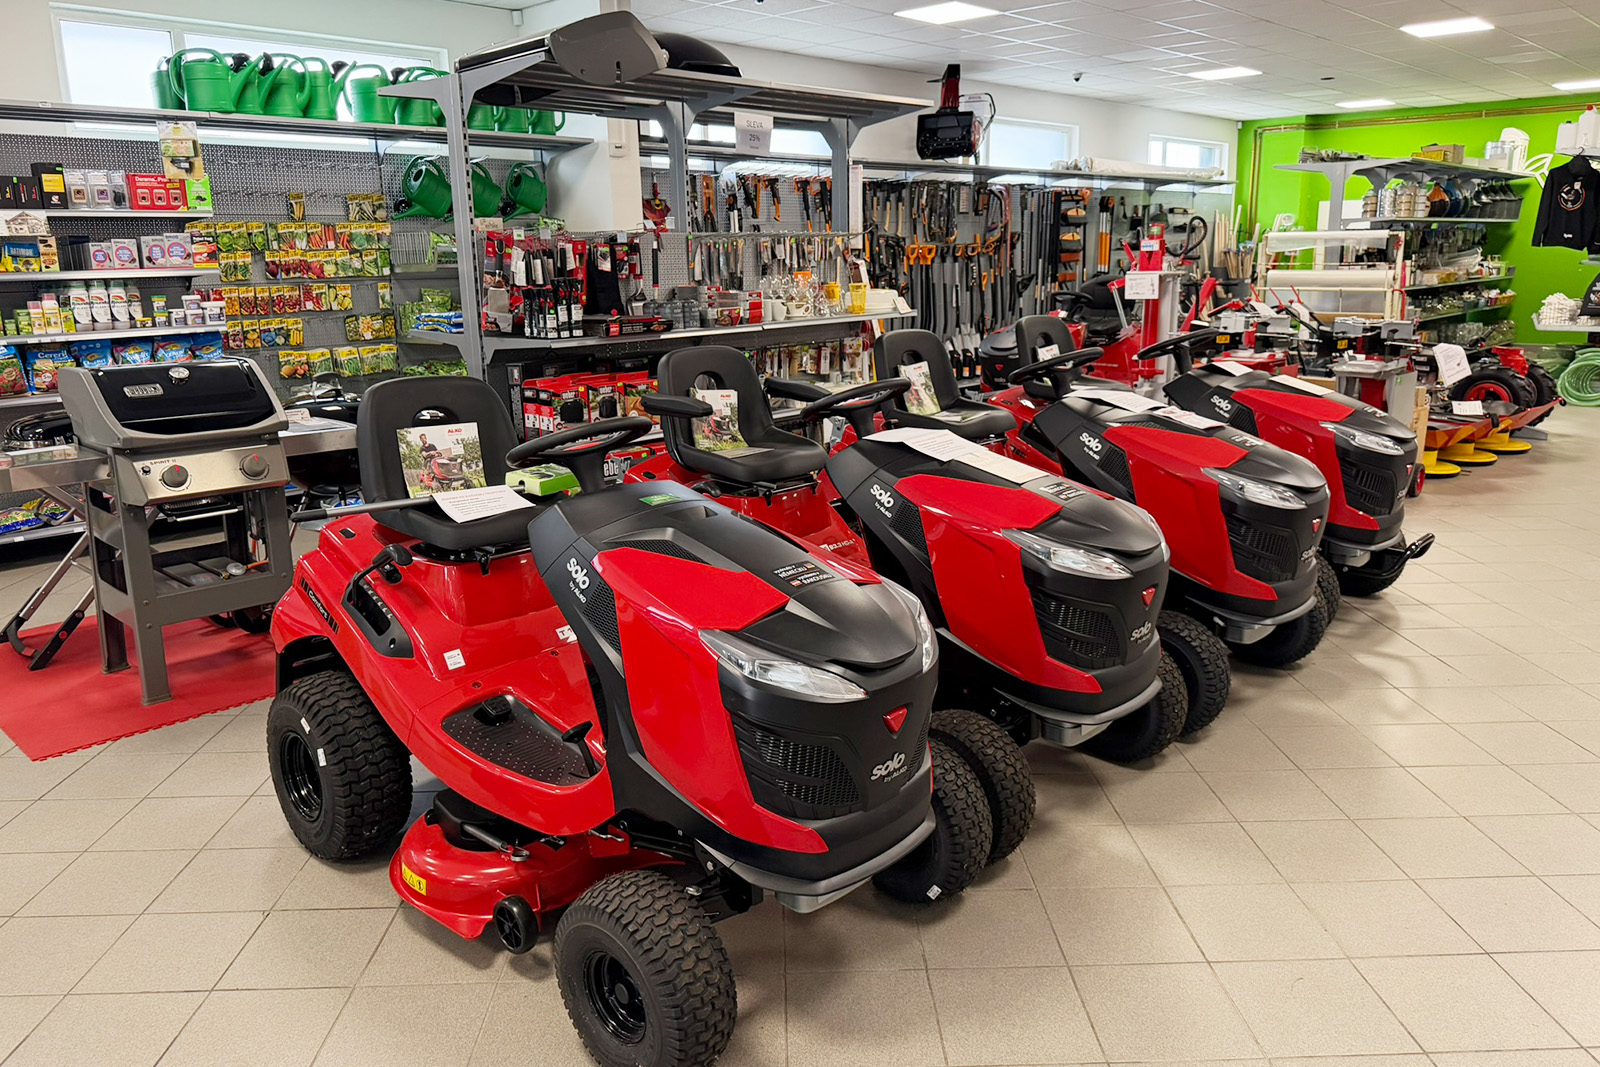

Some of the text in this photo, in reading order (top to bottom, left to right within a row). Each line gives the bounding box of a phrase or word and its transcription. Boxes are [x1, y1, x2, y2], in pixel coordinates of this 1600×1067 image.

[746, 120, 763, 128] SLEVA
[749, 133, 760, 142] 25%
[1211, 395, 1231, 411] solo
[1080, 432, 1102, 452] solo
[870, 484, 894, 508] solo
[567, 557, 590, 590] solo
[309, 590, 328, 619] Comfort
[871, 752, 906, 780] solo
